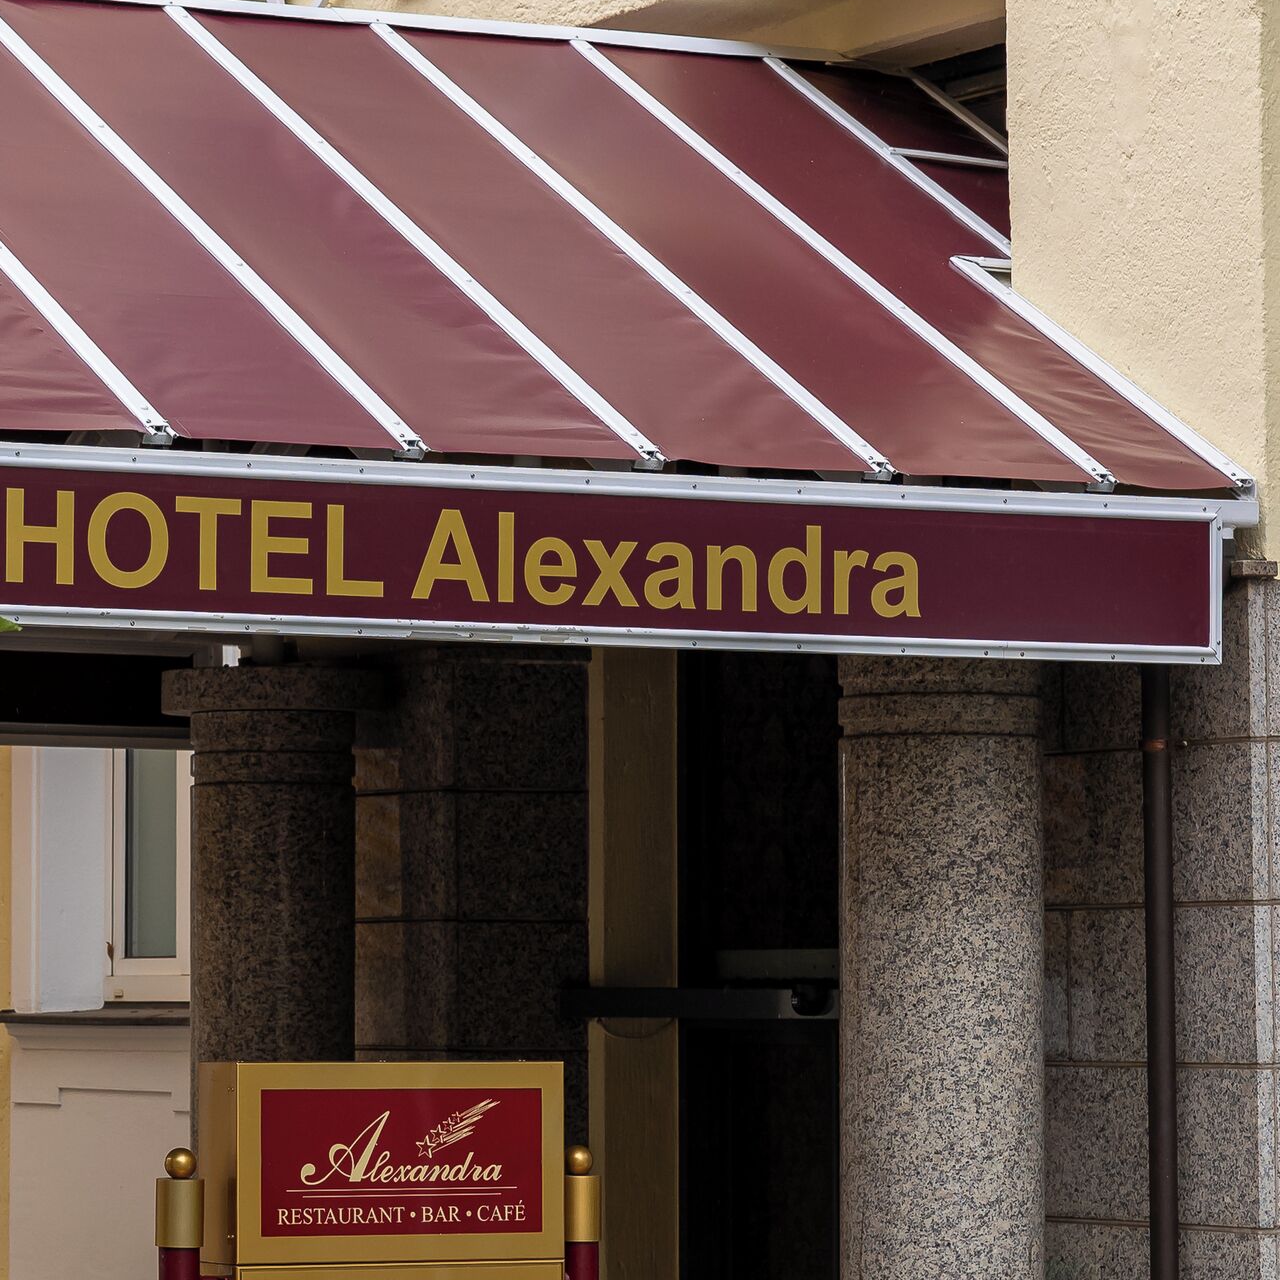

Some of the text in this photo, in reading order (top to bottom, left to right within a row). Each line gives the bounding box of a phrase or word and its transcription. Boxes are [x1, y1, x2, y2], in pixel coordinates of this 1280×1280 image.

[5, 487, 922, 618] HOTEL Alexandra
[300, 1110, 503, 1186] Alexandra
[277, 1199, 526, 1226] RESTAURANT BAR CAFÉ
